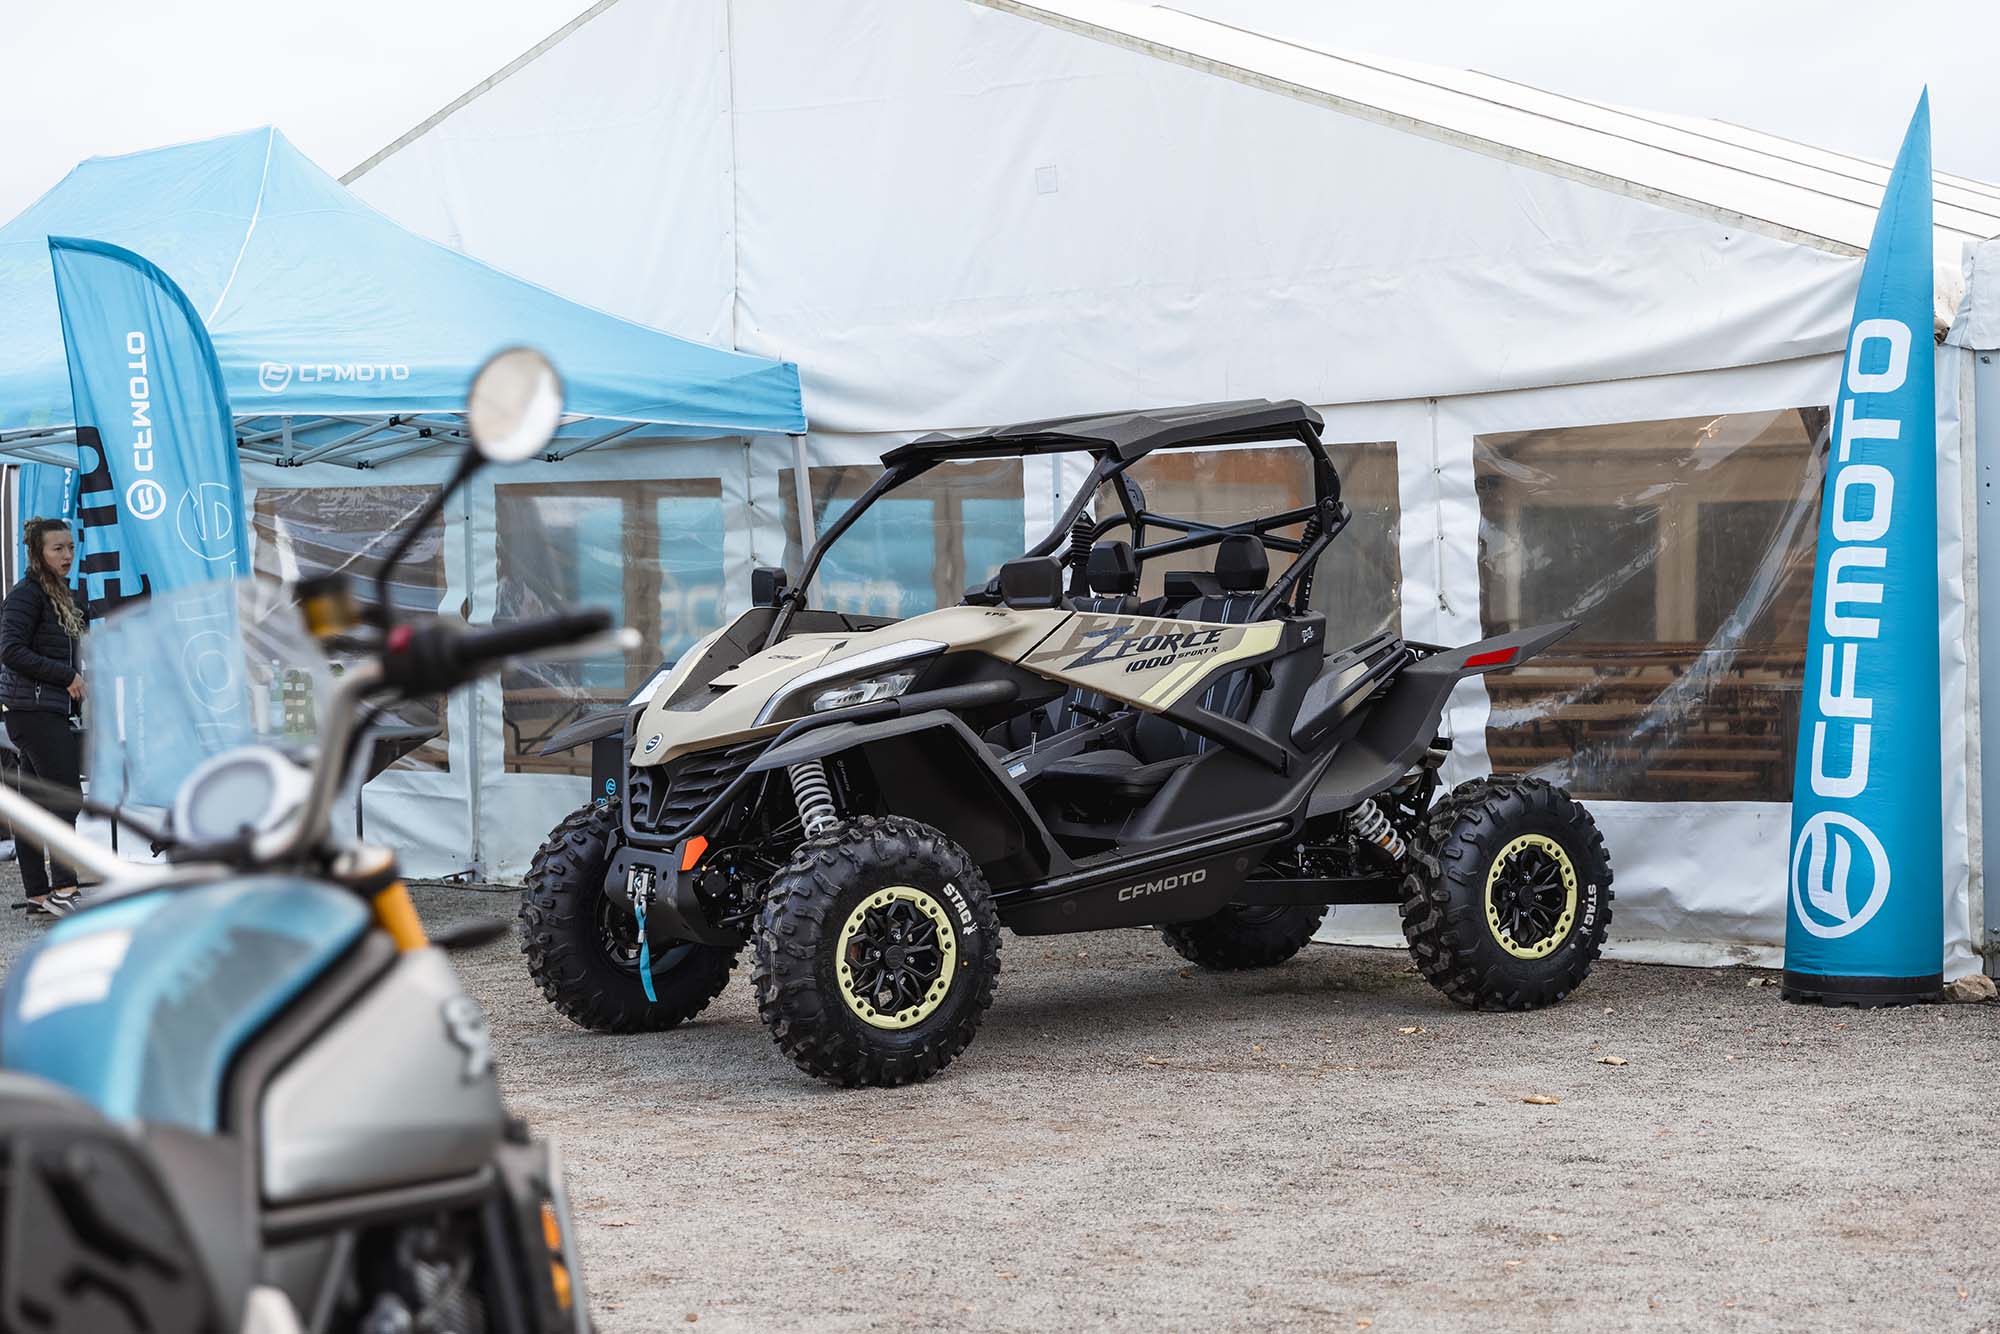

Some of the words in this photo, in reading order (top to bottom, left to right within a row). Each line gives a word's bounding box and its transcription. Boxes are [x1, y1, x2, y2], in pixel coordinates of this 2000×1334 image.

[299, 363, 409, 382] CFMOTO
[1811, 318, 1912, 799] CFMOTO
[1125, 653, 1177, 673] 1000
[1177, 647, 1210, 659] SPORT
[943, 882, 972, 925] STAG
[1118, 868, 1207, 902] CFMOTO
[1584, 883, 1597, 925] STAG
